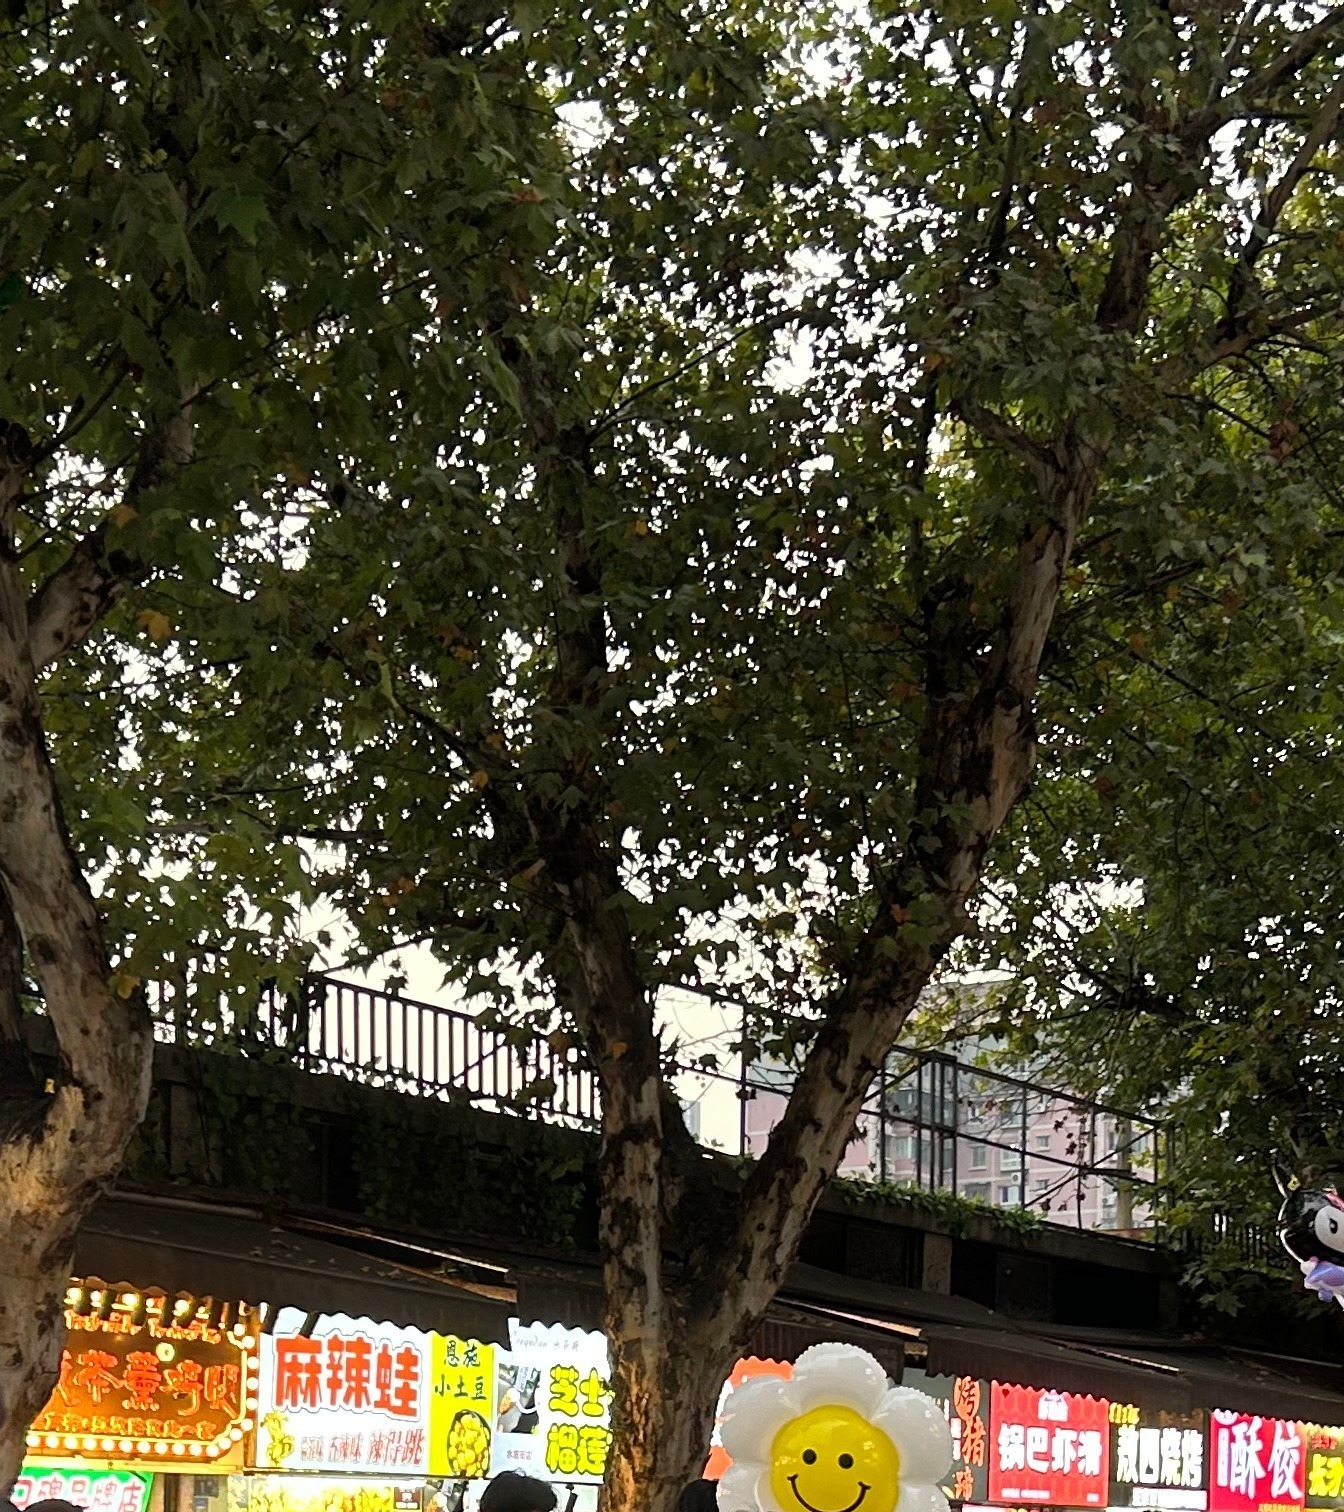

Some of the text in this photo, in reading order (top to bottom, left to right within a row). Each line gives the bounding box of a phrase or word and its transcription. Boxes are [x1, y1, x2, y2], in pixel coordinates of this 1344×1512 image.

[443, 1340, 481, 1368] 恩施
[275, 1335, 420, 1417] 麻辣蛙
[434, 1373, 488, 1401] 小土豆
[549, 1364, 607, 1417] 芝士
